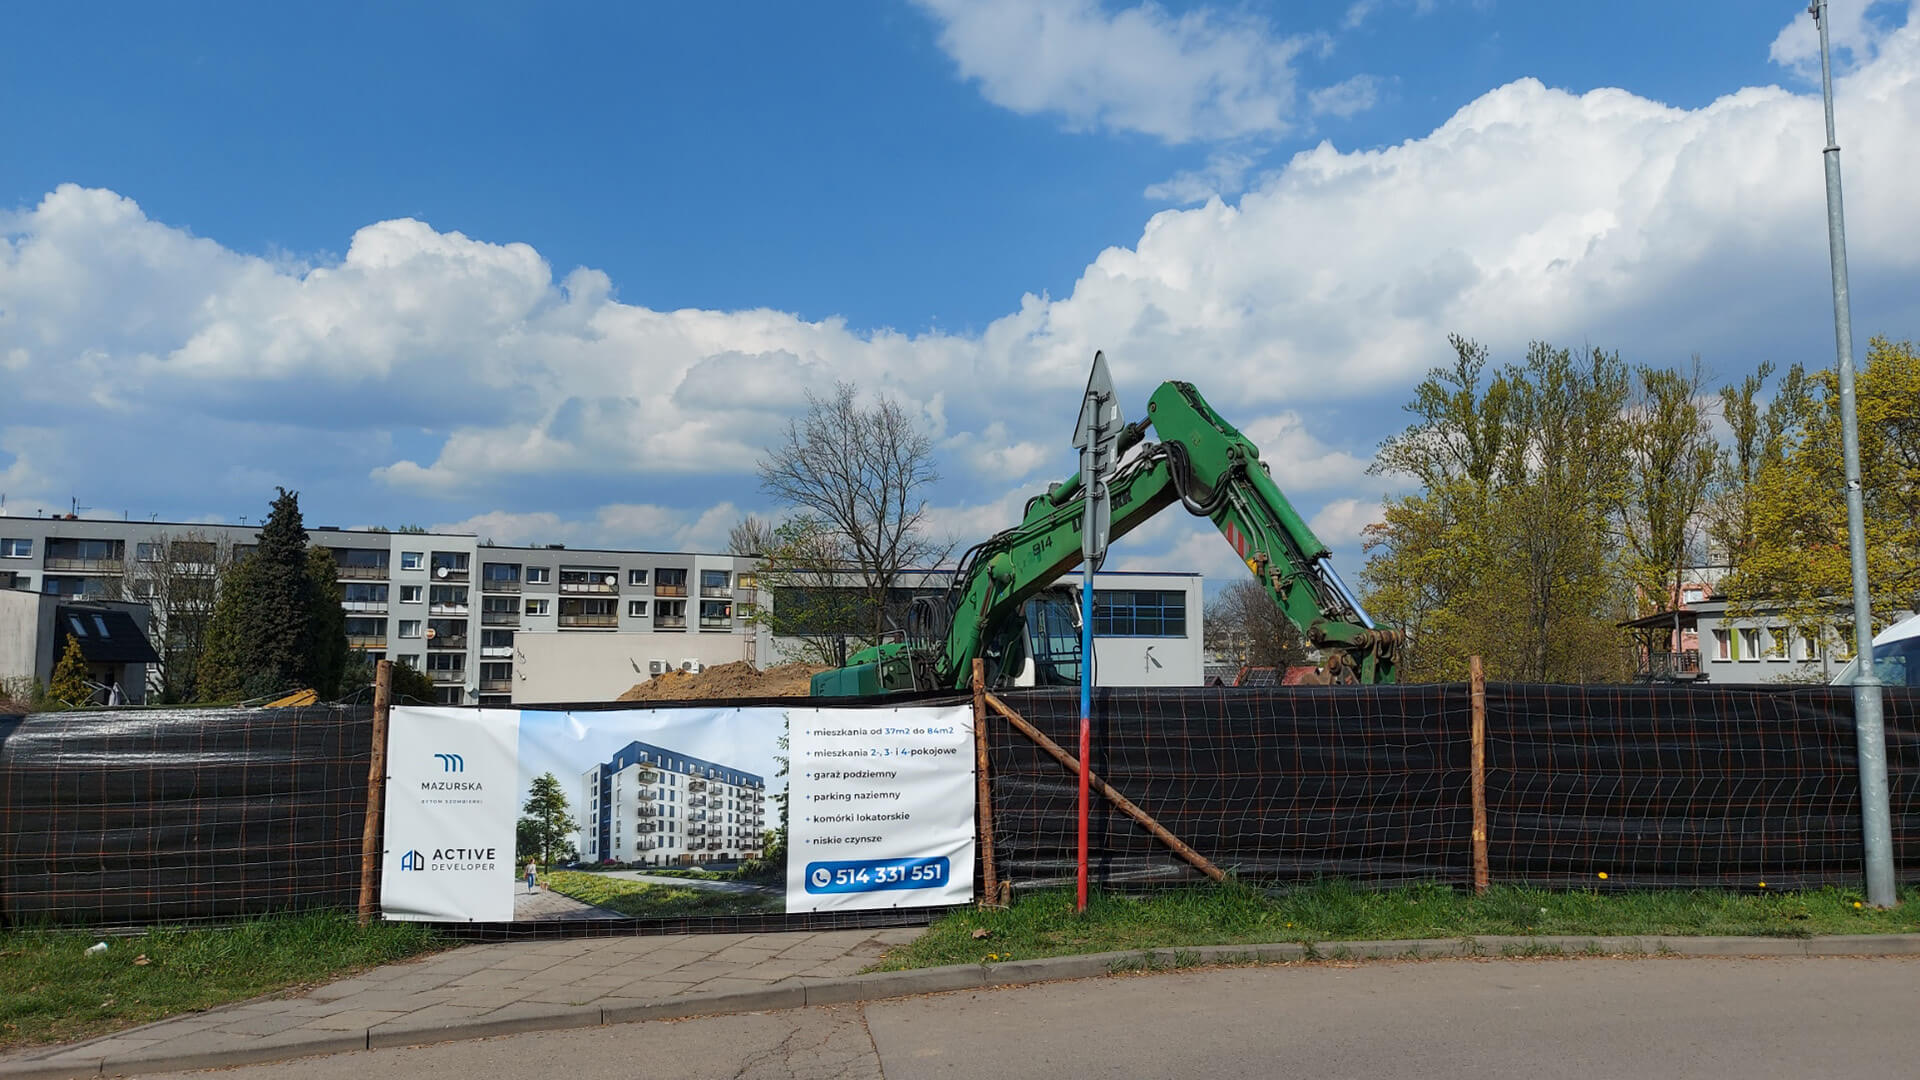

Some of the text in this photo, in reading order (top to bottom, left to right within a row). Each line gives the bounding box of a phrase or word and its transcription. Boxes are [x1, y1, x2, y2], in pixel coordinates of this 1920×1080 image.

[1032, 535, 1053, 556] 914
[813, 726, 954, 737] mieszkania od 37m2 do 84m2
[814, 748, 868, 758] mieszkania
[813, 769, 897, 781] garaż podziemny
[421, 781, 483, 791] MAZURSKA
[813, 791, 901, 803] parking naziemny
[813, 811, 911, 823] komórki lokatorskie
[813, 835, 883, 845] niskie czynsze
[432, 848, 496, 860] ACTIVE
[431, 863, 495, 871] DEVELOPER
[835, 863, 942, 885] 514 331 551
